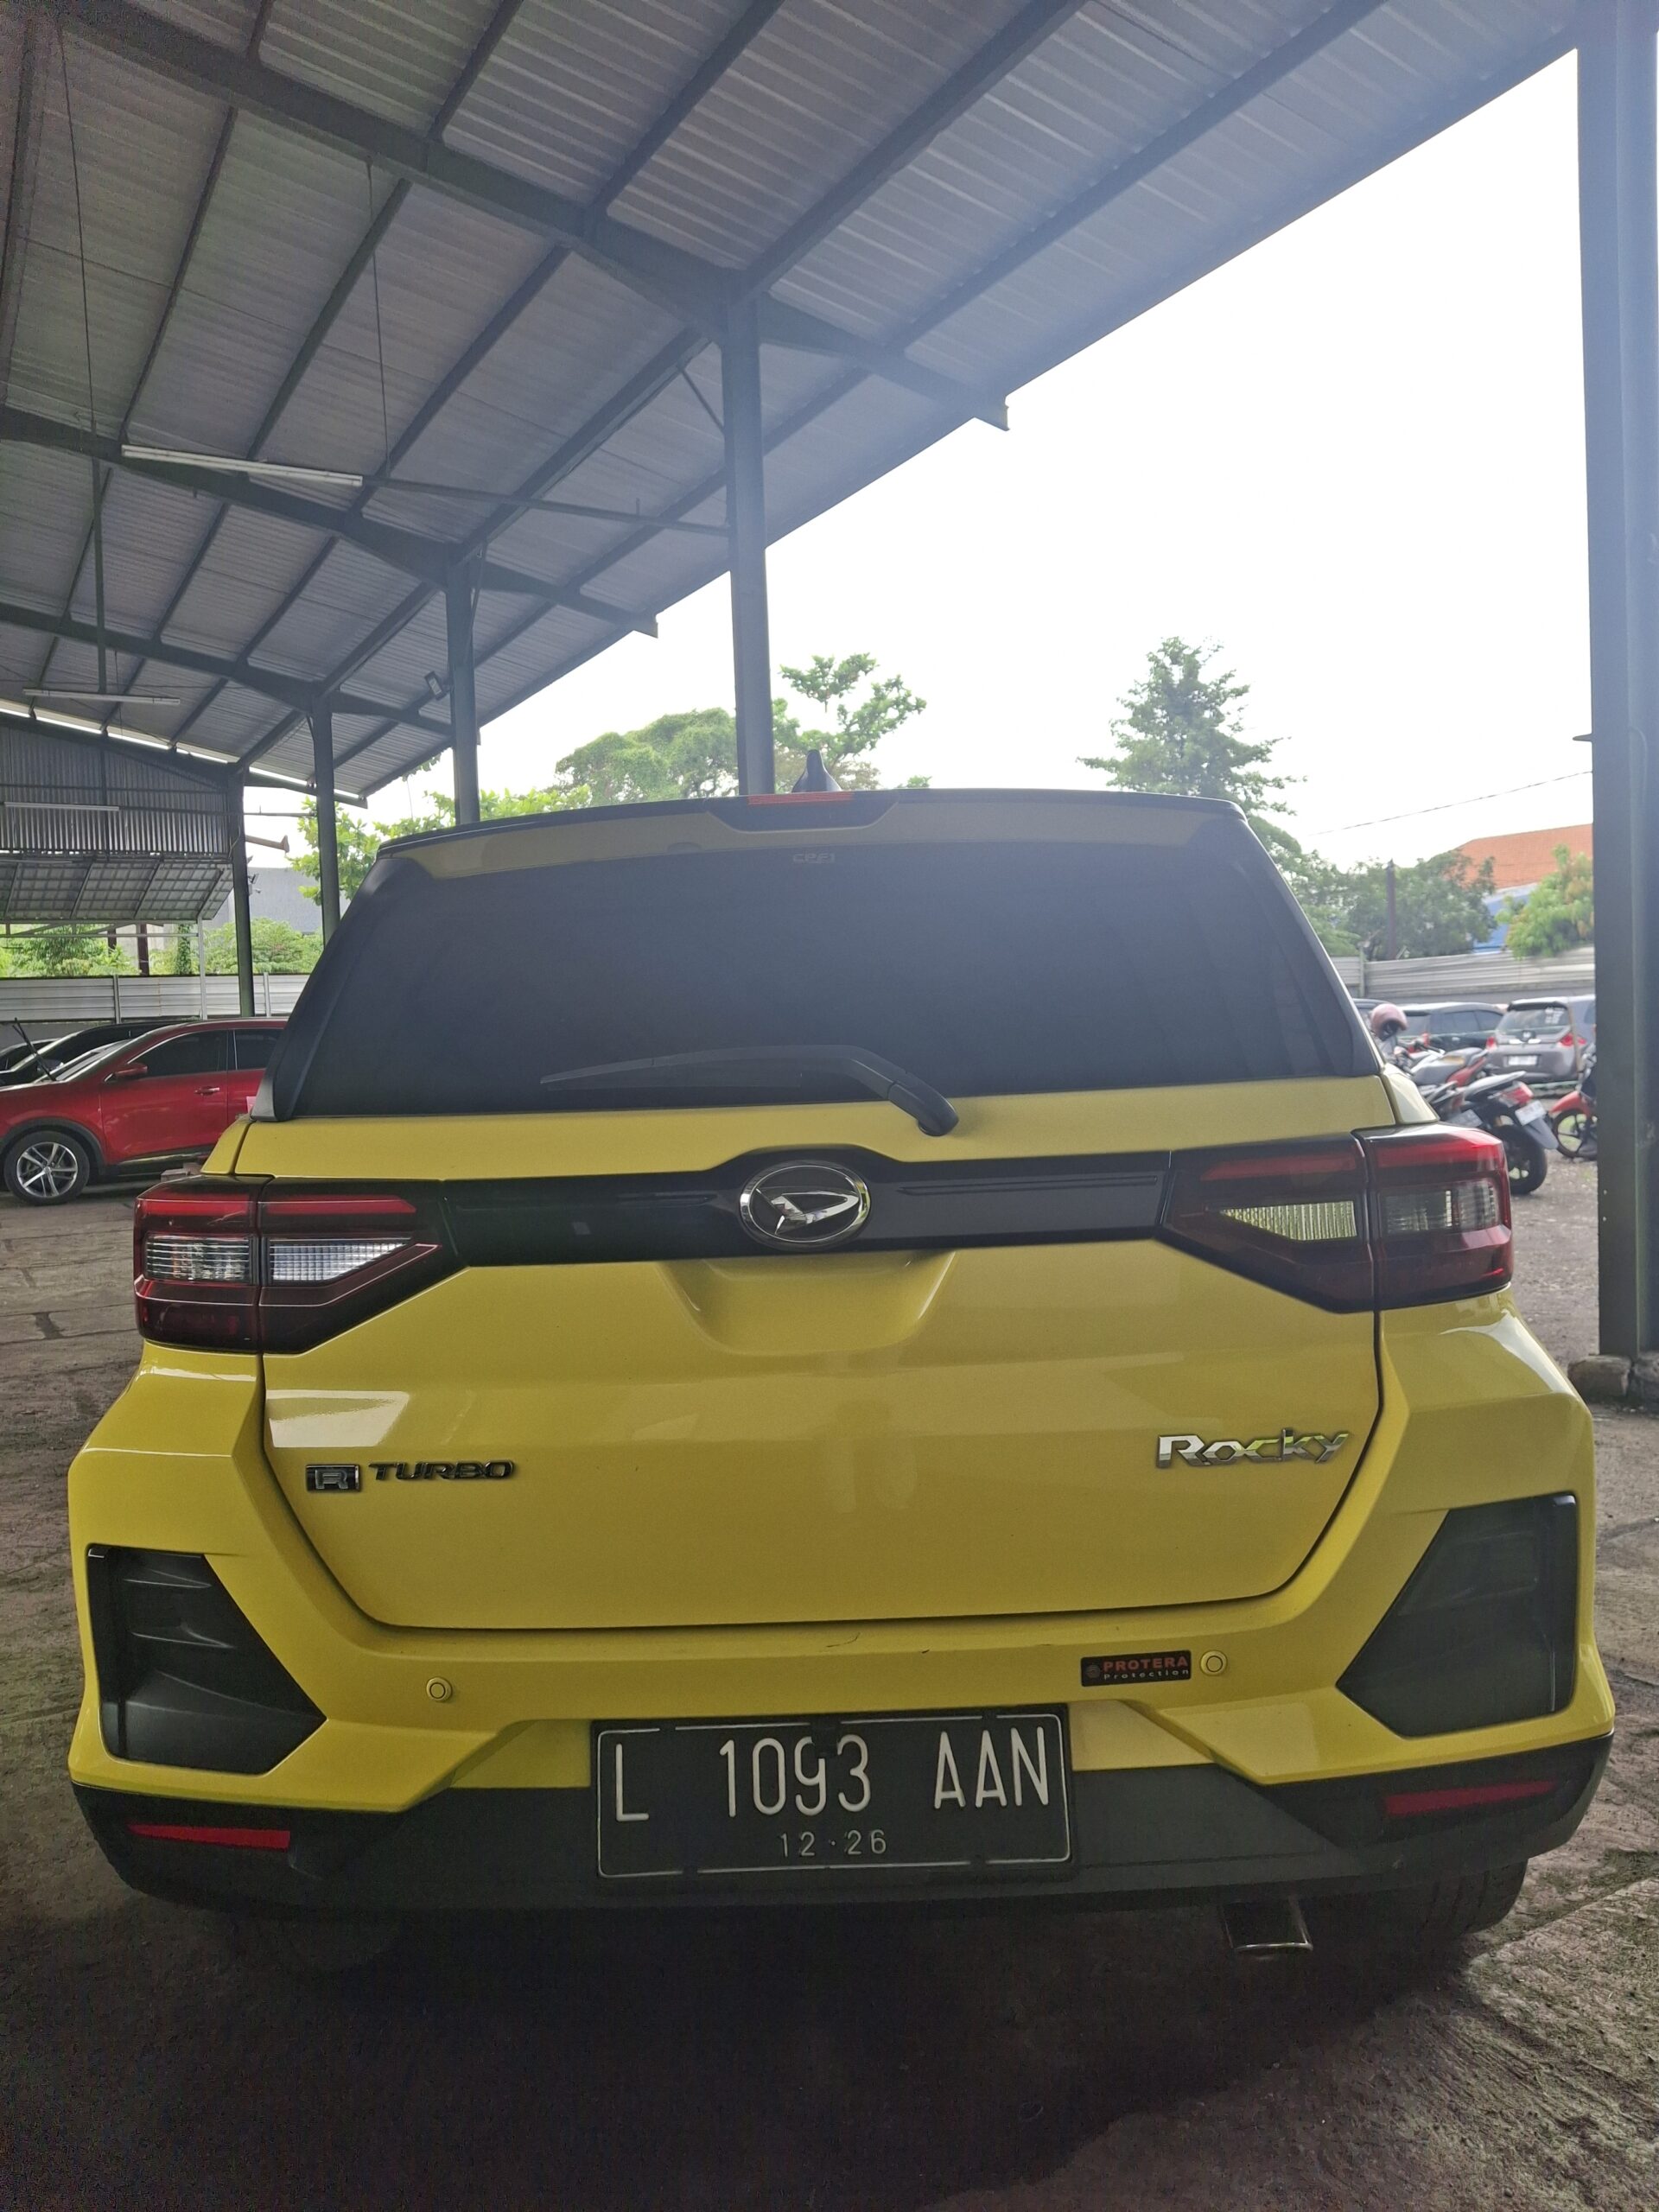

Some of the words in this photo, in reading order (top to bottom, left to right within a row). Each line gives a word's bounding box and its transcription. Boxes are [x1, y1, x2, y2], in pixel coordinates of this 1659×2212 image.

[1157, 1427, 1350, 1468] Rocky
[369, 1459, 516, 1481] TURBO
[1103, 1656, 1189, 1673] PROTERA
[615, 1743, 650, 1821] L
[719, 1733, 871, 1818] 1093
[933, 1726, 1050, 1809] AAN
